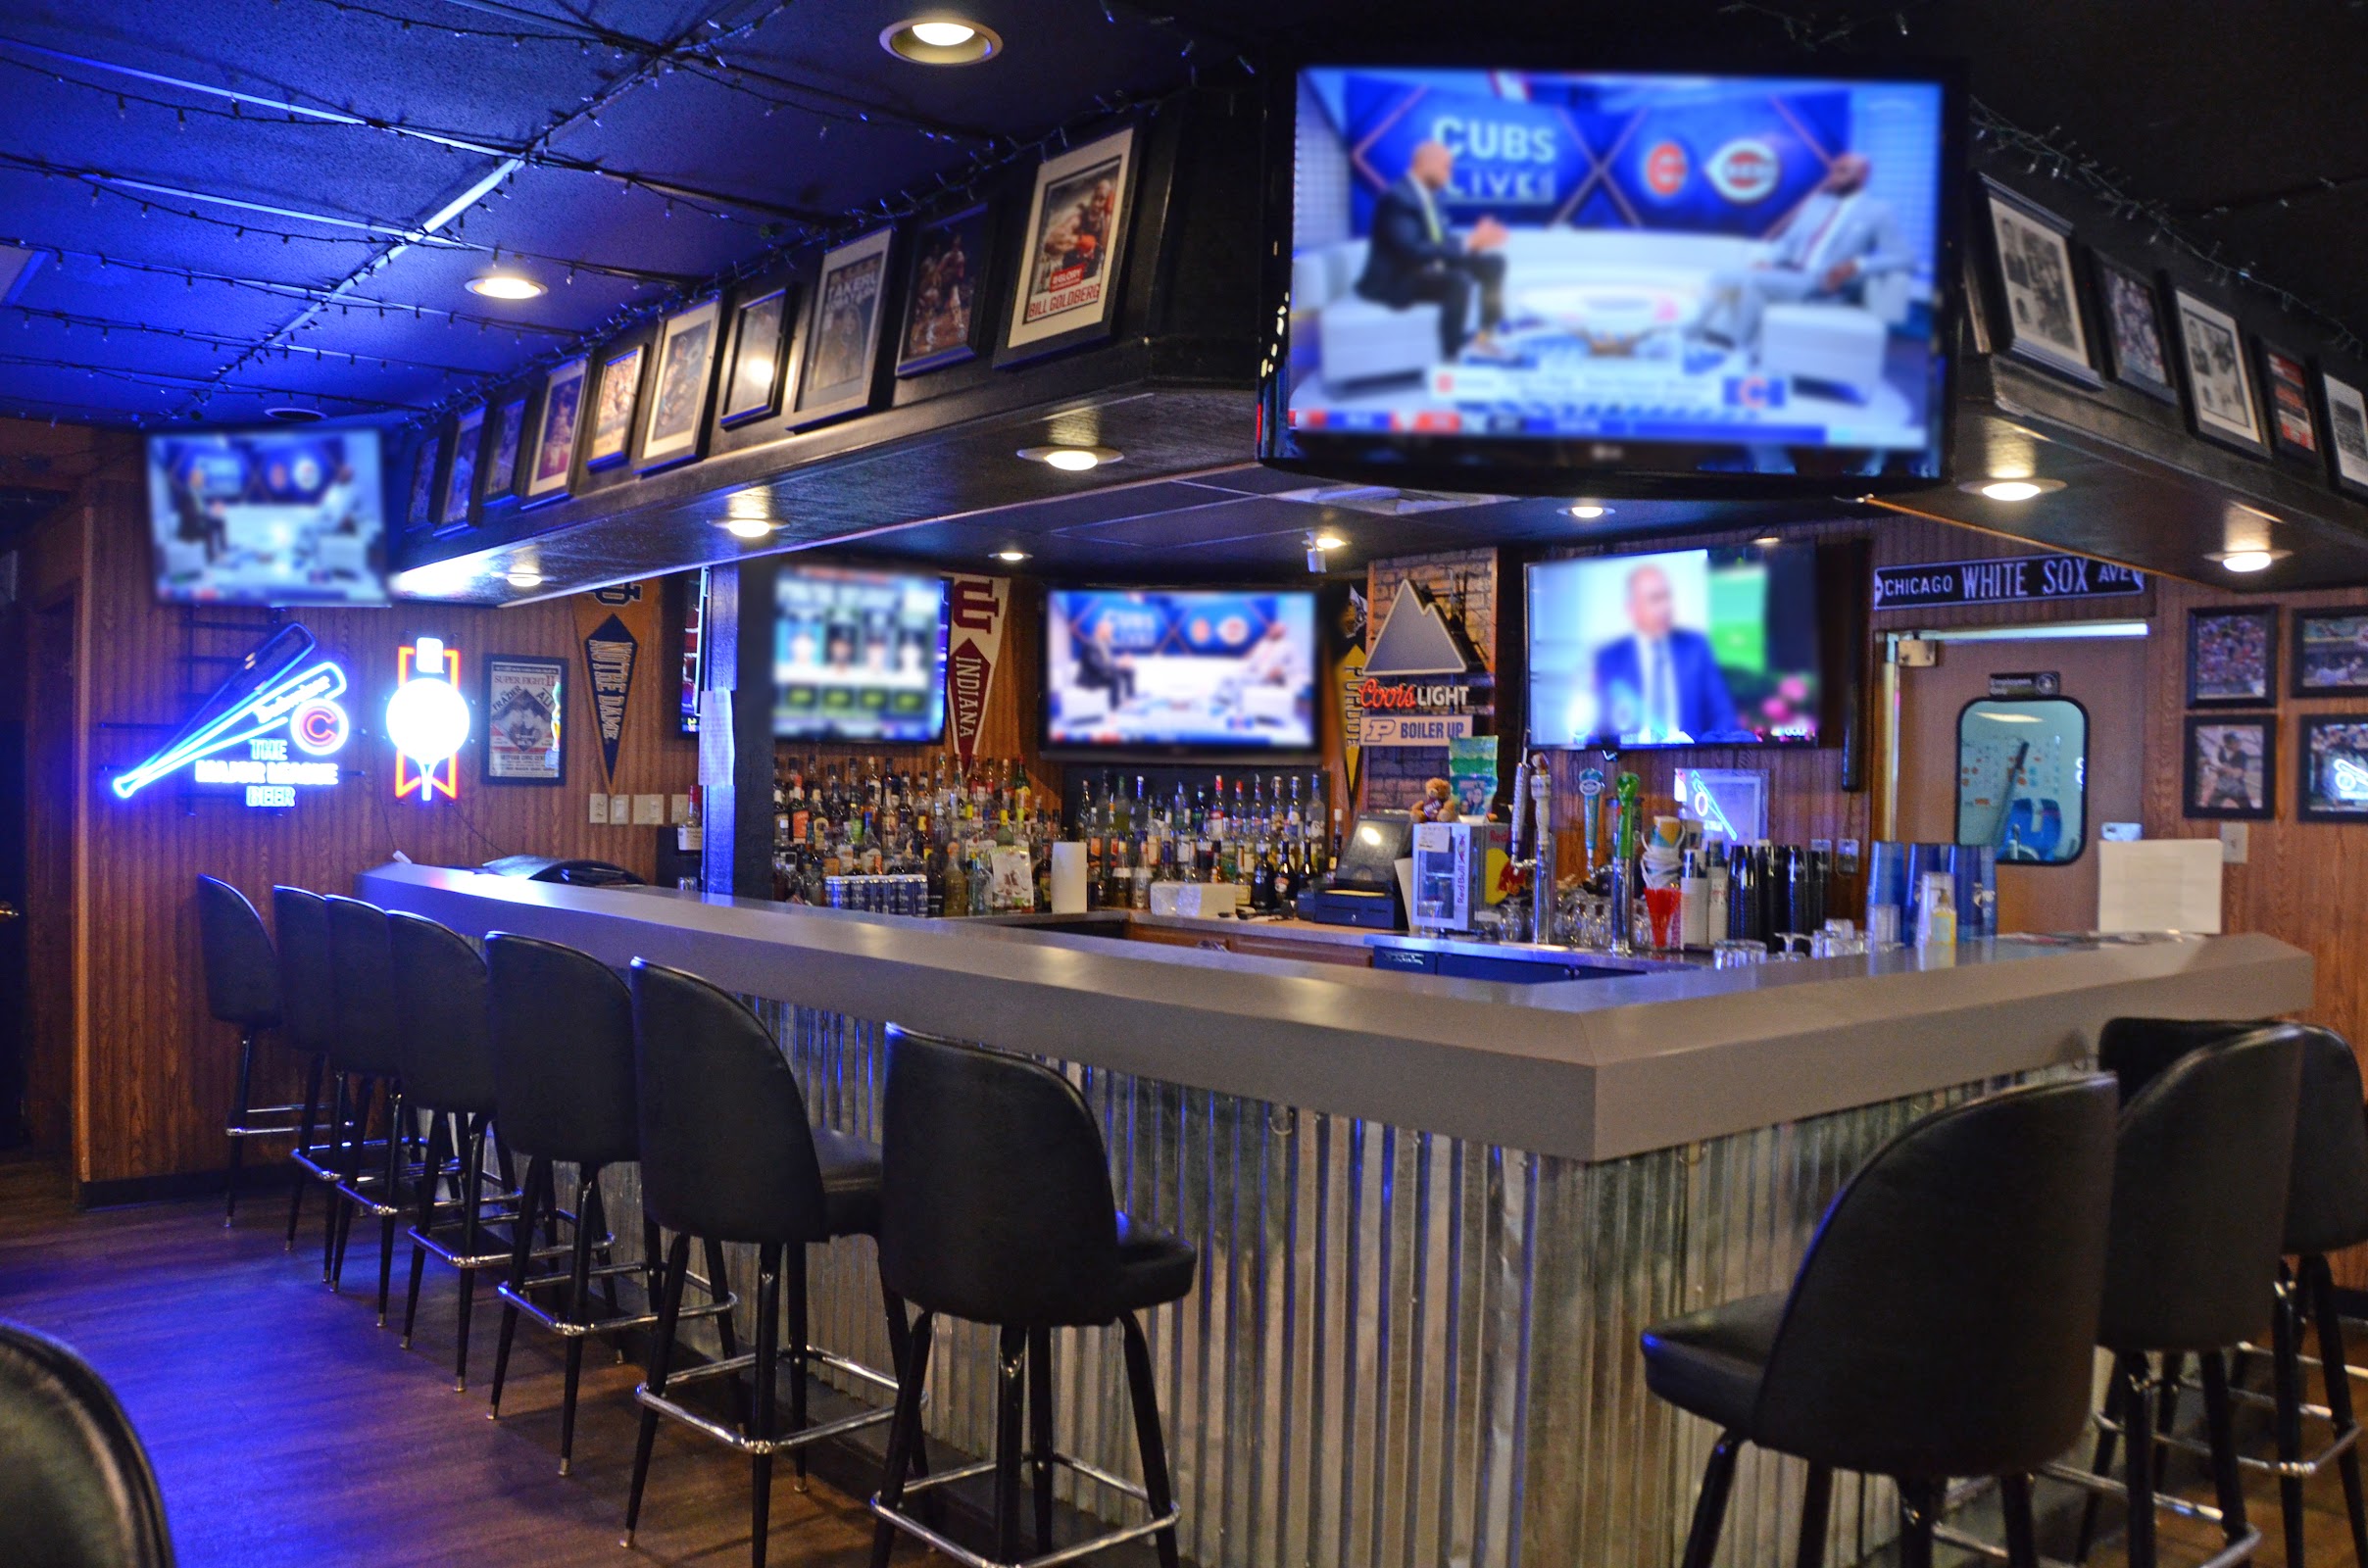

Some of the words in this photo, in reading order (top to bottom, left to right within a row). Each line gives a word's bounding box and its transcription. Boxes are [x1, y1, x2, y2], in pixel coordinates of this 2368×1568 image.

[1433, 116, 1556, 163] CUBS
[1028, 298, 1047, 318] BILL
[1049, 283, 1101, 312] GOLDBERG
[1884, 574, 1953, 598] CHICAGO
[1961, 562, 2029, 600] WHITE
[2042, 558, 2090, 596] SOX
[2098, 564, 2132, 584] AVE
[494, 674, 521, 685] SUPER
[521, 676, 547, 686] FIGHT
[588, 639, 633, 694] NOTRE
[492, 685, 523, 711] FRAZIER
[955, 655, 982, 738] INDIANA
[1358, 677, 1417, 710] Coors
[1416, 685, 1470, 707] LIGHT
[597, 694, 625, 741] DAME
[1401, 721, 1445, 740] BOILER
[1447, 721, 1465, 739] UP
[248, 738, 288, 760] THE
[246, 785, 296, 807] BEER
